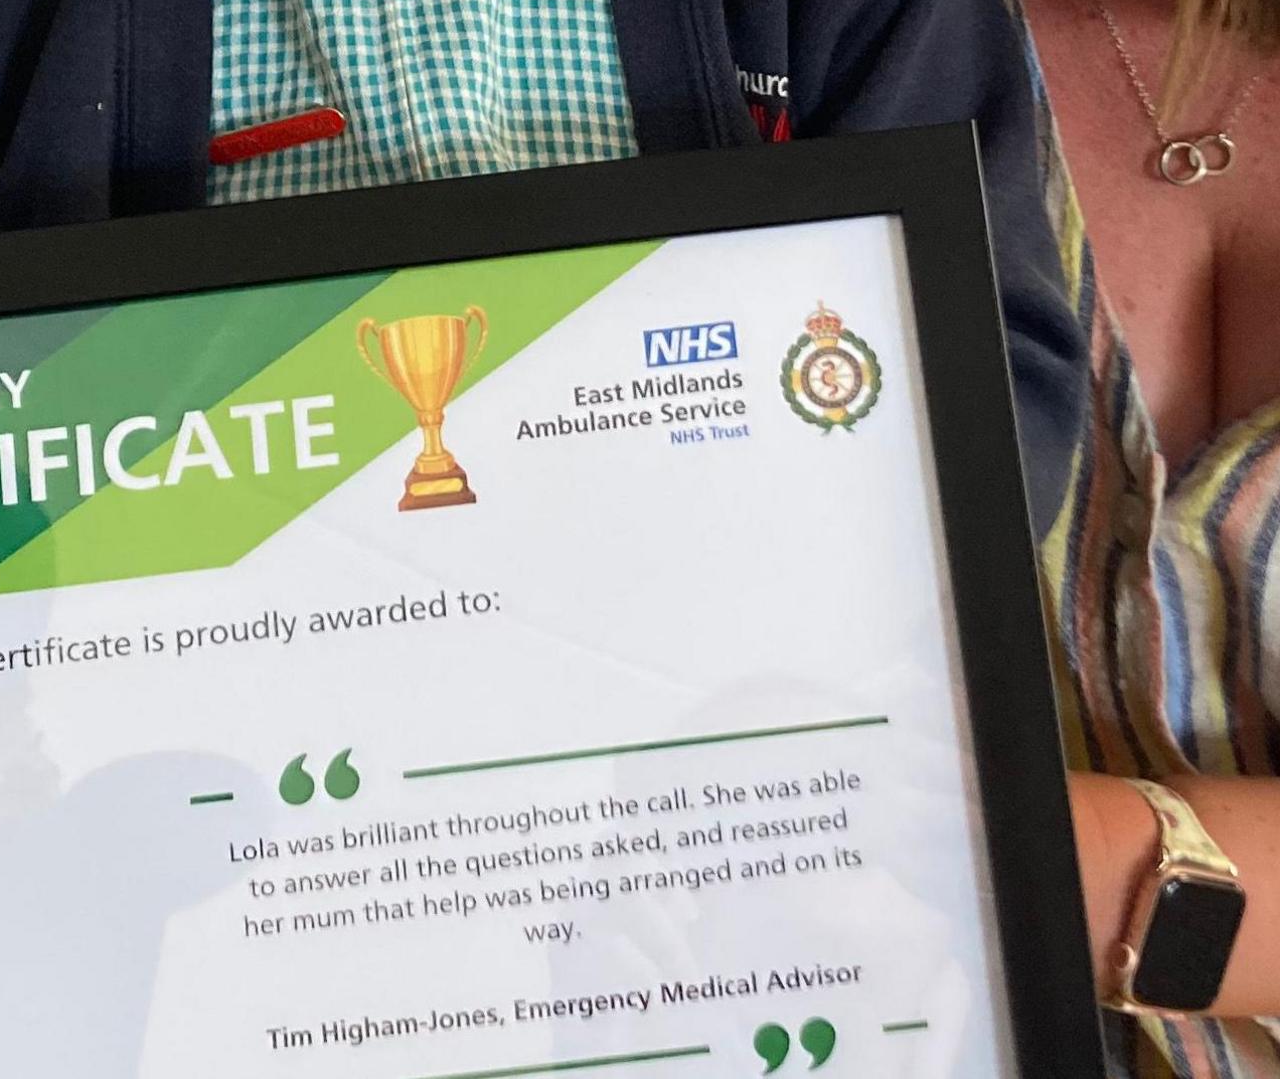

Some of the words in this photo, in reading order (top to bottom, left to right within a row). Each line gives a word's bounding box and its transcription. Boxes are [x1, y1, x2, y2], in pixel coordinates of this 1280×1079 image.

[648, 323, 733, 365] NHS
[573, 381, 624, 408] East
[631, 370, 744, 402] Midlands
[516, 407, 653, 441] Ambulance
[660, 397, 747, 425] Service
[670, 427, 706, 445] NHS
[709, 423, 751, 442] Trust
[142, 624, 166, 655] is
[175, 612, 298, 657] proudly
[308, 593, 448, 633] awarded
[457, 590, 500, 615] to:
[230, 838, 279, 862] Lola
[288, 834, 334, 856] was
[343, 820, 439, 850] brilliant
[447, 804, 589, 834] throughout
[600, 796, 639, 819] the
[647, 787, 694, 812] call.
[703, 783, 746, 806] She
[754, 779, 801, 801] was
[809, 769, 862, 794] able
[249, 879, 275, 898] to
[284, 868, 370, 894] answer
[380, 858, 407, 883] all
[417, 856, 457, 878] the
[465, 844, 583, 877] questions
[591, 827, 668, 858] asked,
[677, 821, 723, 849] and
[732, 807, 849, 842] reassured
[244, 915, 283, 937] her
[293, 909, 355, 931] mum
[364, 899, 415, 922] that
[423, 891, 477, 917] help
[485, 886, 532, 908] was
[540, 877, 610, 903] being
[619, 858, 732, 892] arranged
[740, 854, 786, 879] and
[794, 852, 825, 871] on
[835, 846, 863, 868] its
[524, 921, 582, 944] way.
[266, 1026, 312, 1050] Tim
[321, 1005, 506, 1047] Higham-Jones,
[514, 990, 651, 1021] Emergency
[660, 971, 758, 1004] Medical
[767, 964, 862, 993] Advisor
